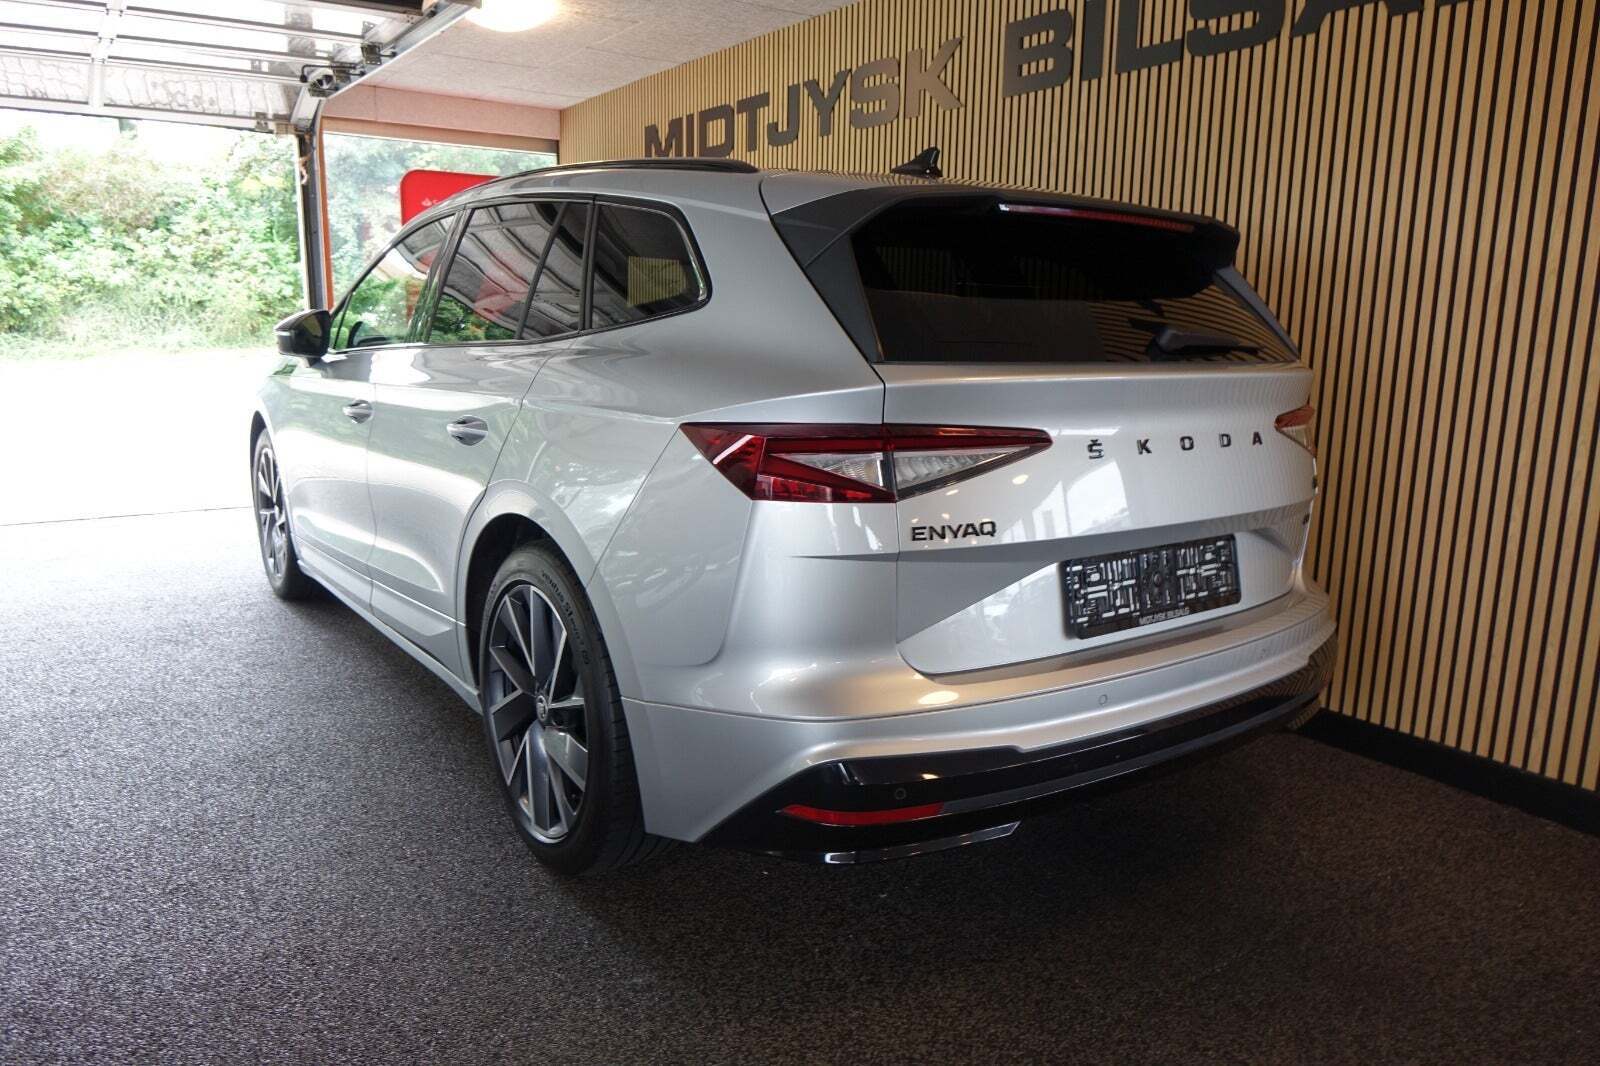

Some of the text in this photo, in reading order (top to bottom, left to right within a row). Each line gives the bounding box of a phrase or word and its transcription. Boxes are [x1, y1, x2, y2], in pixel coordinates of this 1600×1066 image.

[643, 0, 1470, 158] MIDTJYSK BILS
[1086, 431, 1264, 460] ŠKODA
[911, 521, 997, 541] ENYAQ
